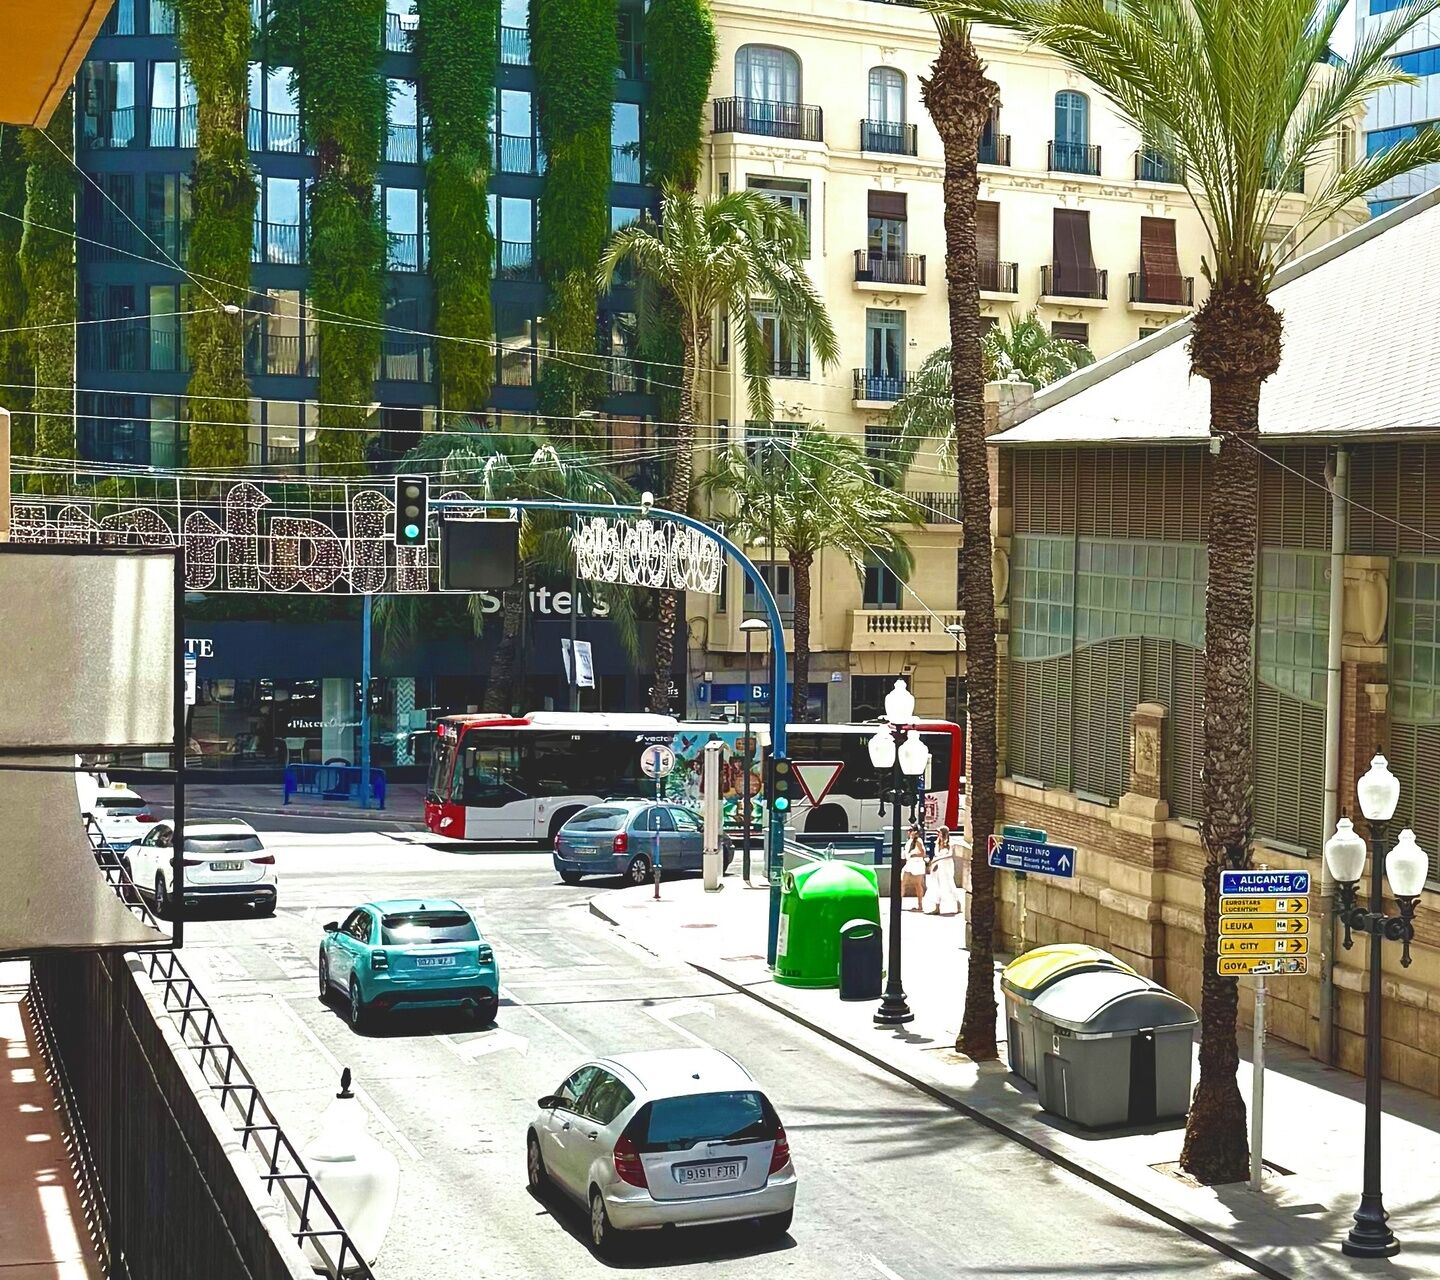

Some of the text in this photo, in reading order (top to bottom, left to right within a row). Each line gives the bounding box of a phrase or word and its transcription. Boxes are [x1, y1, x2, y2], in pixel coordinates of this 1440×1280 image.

[477, 583, 610, 614] Siters
[1007, 844, 1050, 857] TOURIST INFO
[1240, 875, 1290, 884] ALICANTE
[1225, 922, 1254, 930] LEUKA
[1223, 962, 1248, 970] GOYA
[687, 1167, 711, 1180] 9191
